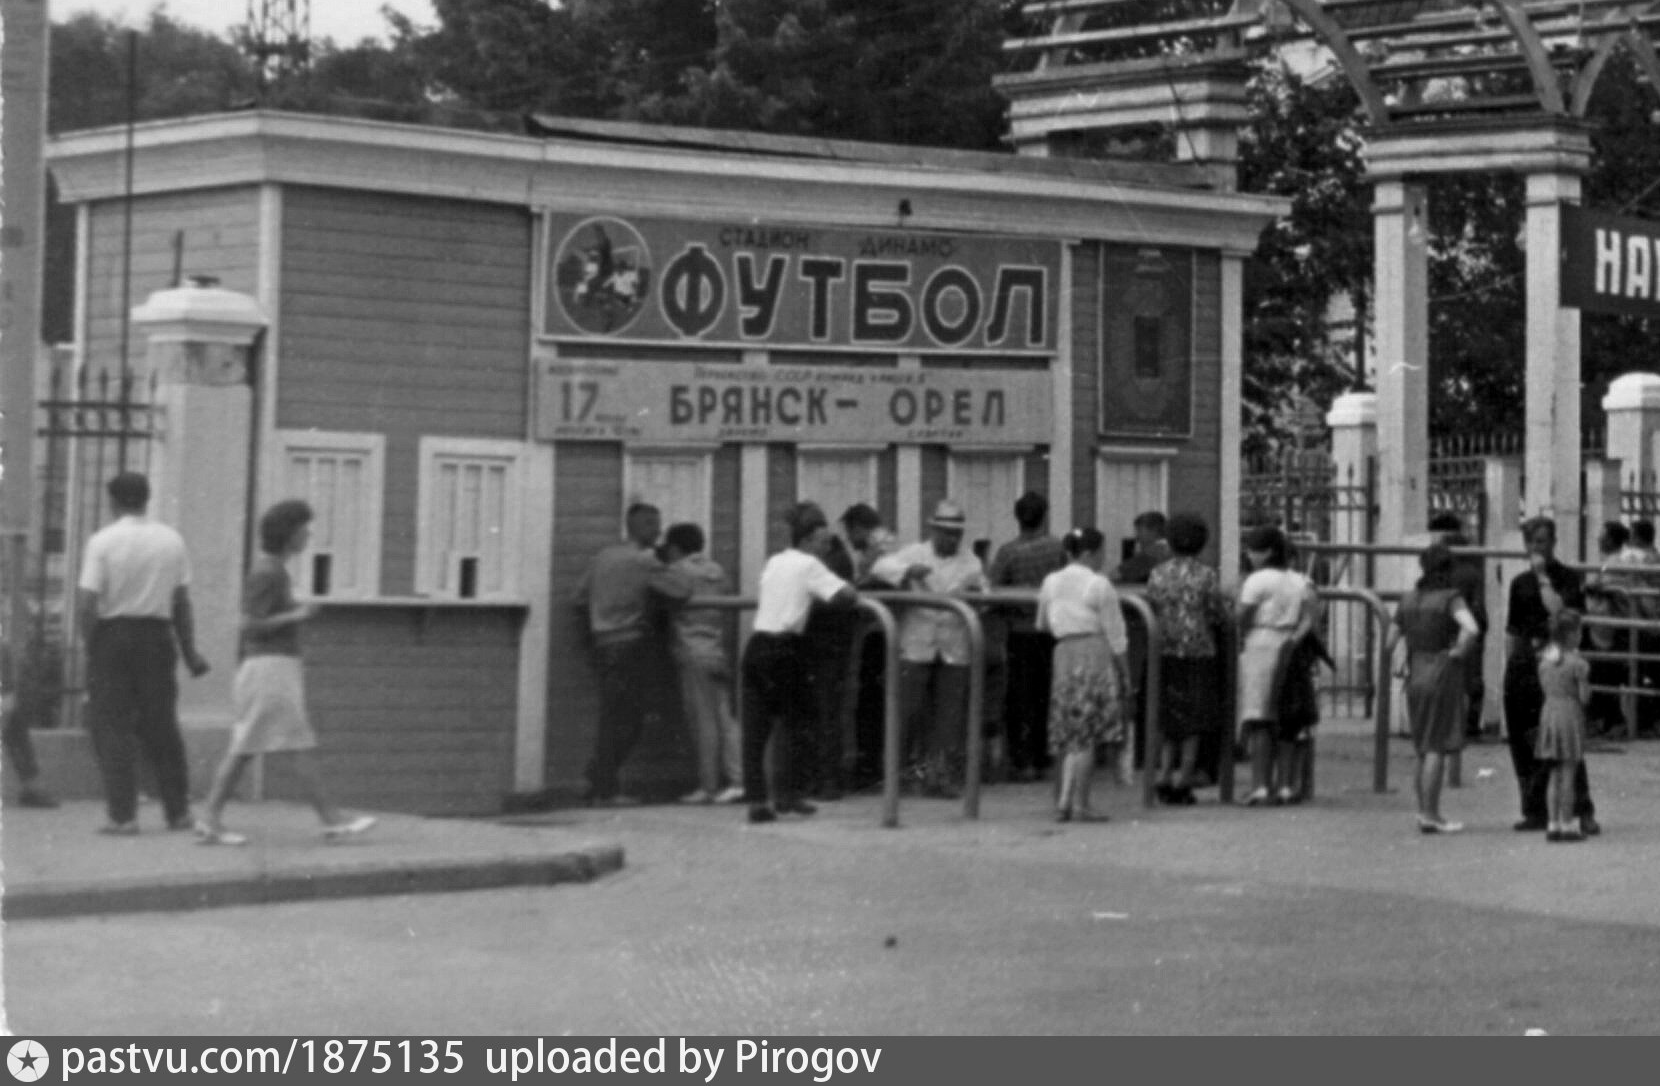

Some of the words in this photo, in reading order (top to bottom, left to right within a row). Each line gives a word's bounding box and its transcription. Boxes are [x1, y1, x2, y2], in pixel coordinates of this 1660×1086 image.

[719, 226, 809, 250] СТАДИОН
[858, 235, 957, 258] ДИНАМО
[660, 242, 1048, 349] ФУТБОЛ
[561, 380, 600, 423] 17
[889, 388, 1005, 427] ОРЕЛ
